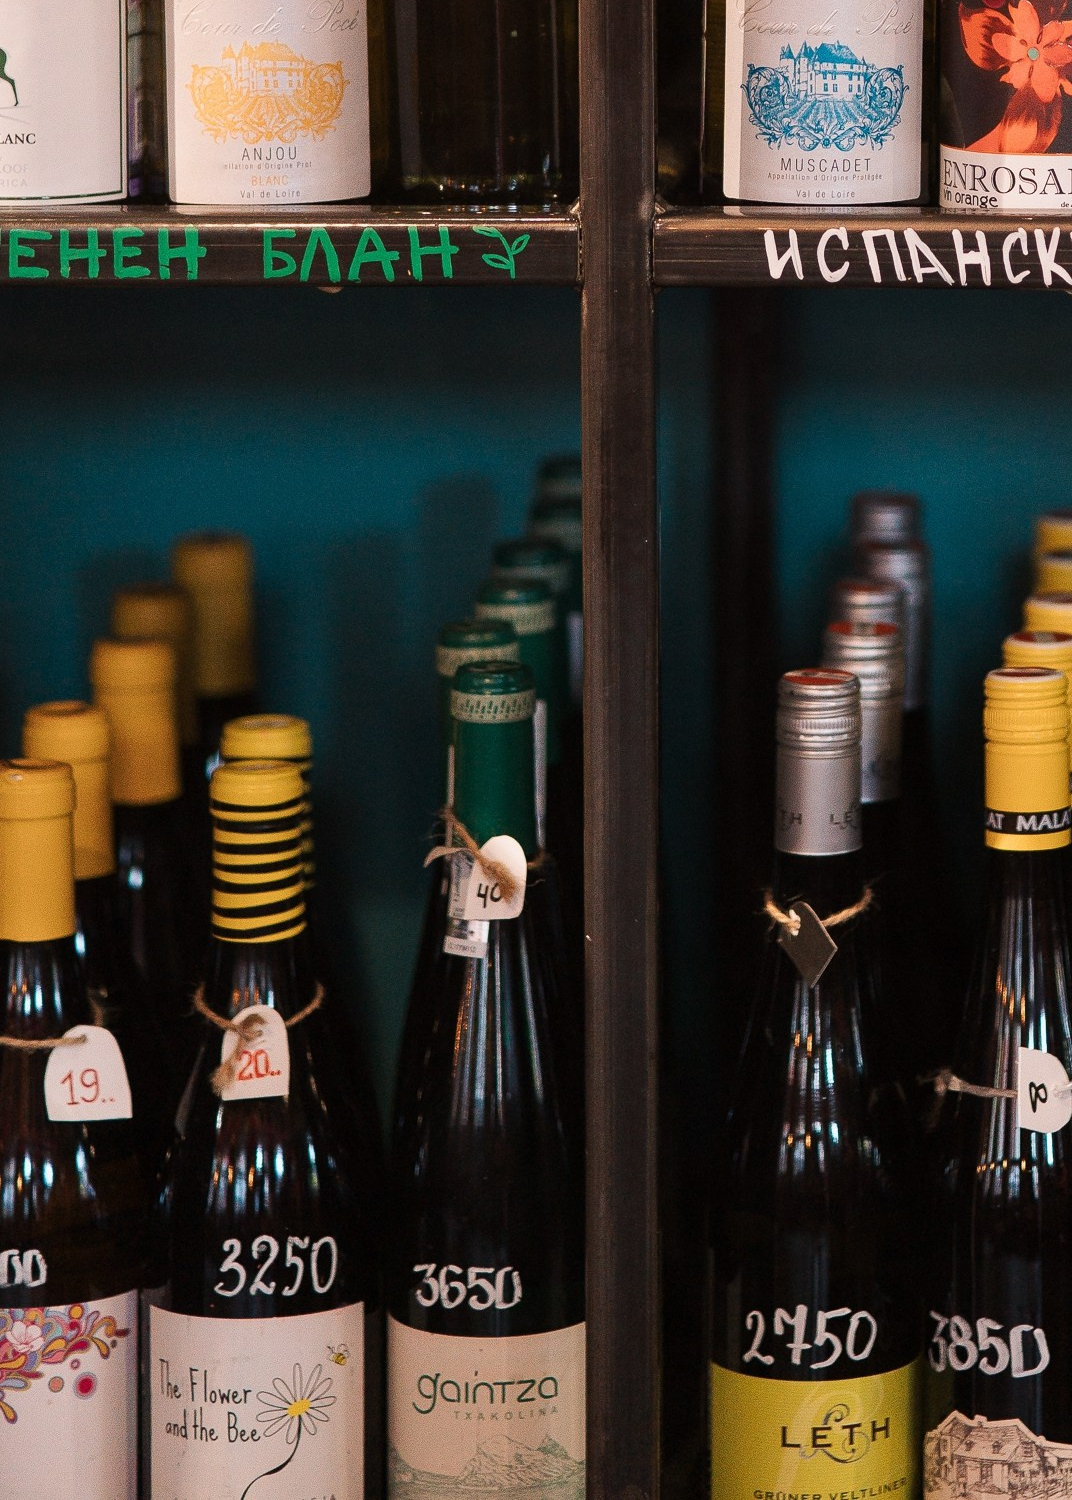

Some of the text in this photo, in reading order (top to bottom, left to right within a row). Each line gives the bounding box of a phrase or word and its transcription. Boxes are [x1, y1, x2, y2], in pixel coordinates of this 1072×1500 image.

[241, 146, 298, 161] ANJOU
[780, 157, 871, 173] MUSCADET
[251, 174, 289, 187] BLANC
[767, 172, 810, 181] Appellation
[813, 174, 849, 183] d'Origine
[239, 189, 301, 199] Val de Loire
[796, 189, 856, 199] Val de Loire
[954, 189, 999, 211] orange
[1060, 199, 1070, 208] de
[263, 224, 460, 284] БЛАН
[213, 1233, 338, 1298] 3250
[412, 1262, 523, 1311] 3650
[742, 1303, 878, 1370] 2750
[929, 1309, 1050, 1378] 3850
[159, 1357, 252, 1405] The Flower
[411, 1370, 559, 1415] gaintza
[165, 1408, 262, 1444] and the Bee
[780, 1416, 891, 1450] LETH
[829, 1476, 908, 1500] VELTLINER
